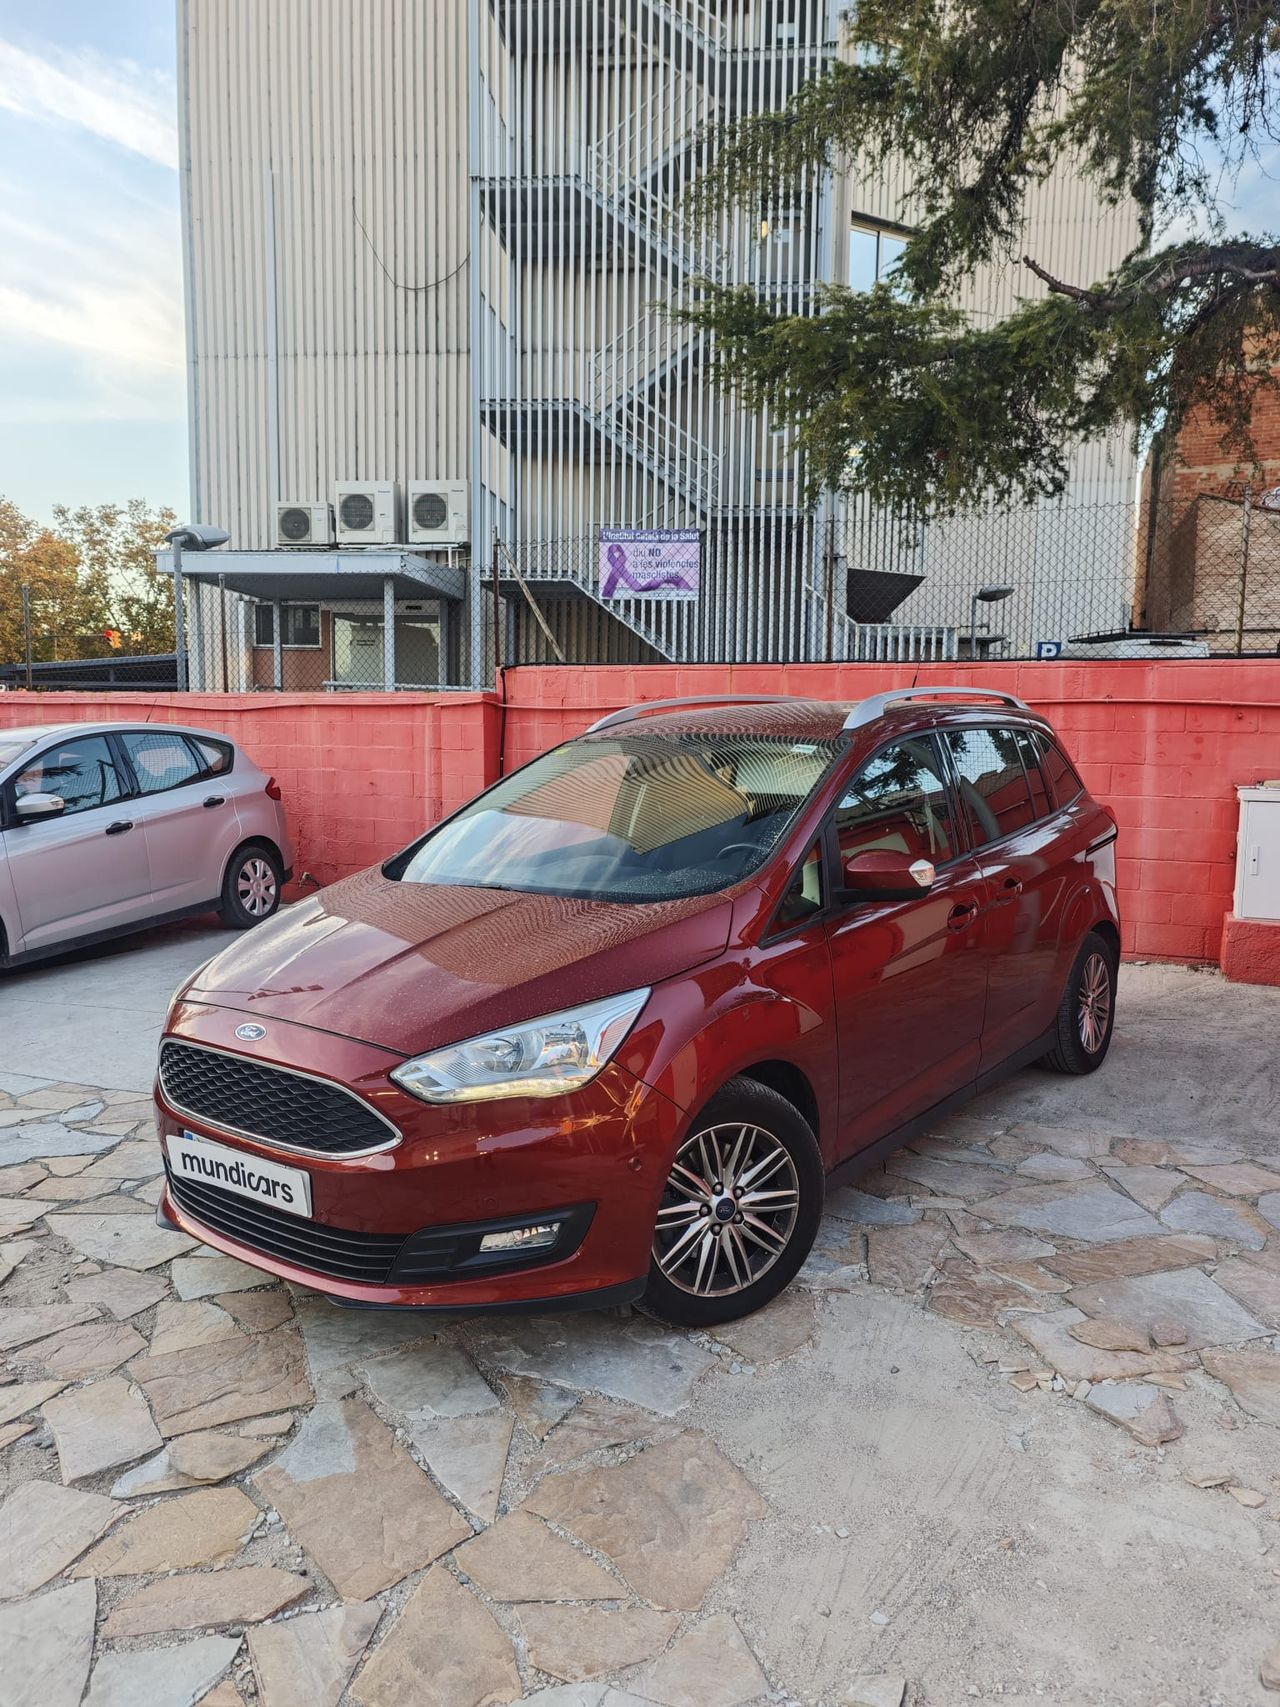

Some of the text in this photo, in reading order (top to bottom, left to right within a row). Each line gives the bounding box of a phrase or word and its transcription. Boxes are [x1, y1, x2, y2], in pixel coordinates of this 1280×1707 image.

[679, 531, 700, 541] Salut
[648, 548, 661, 558] NO
[632, 560, 639, 569] a
[640, 559, 653, 569] les
[181, 1152, 294, 1203] mundicars
